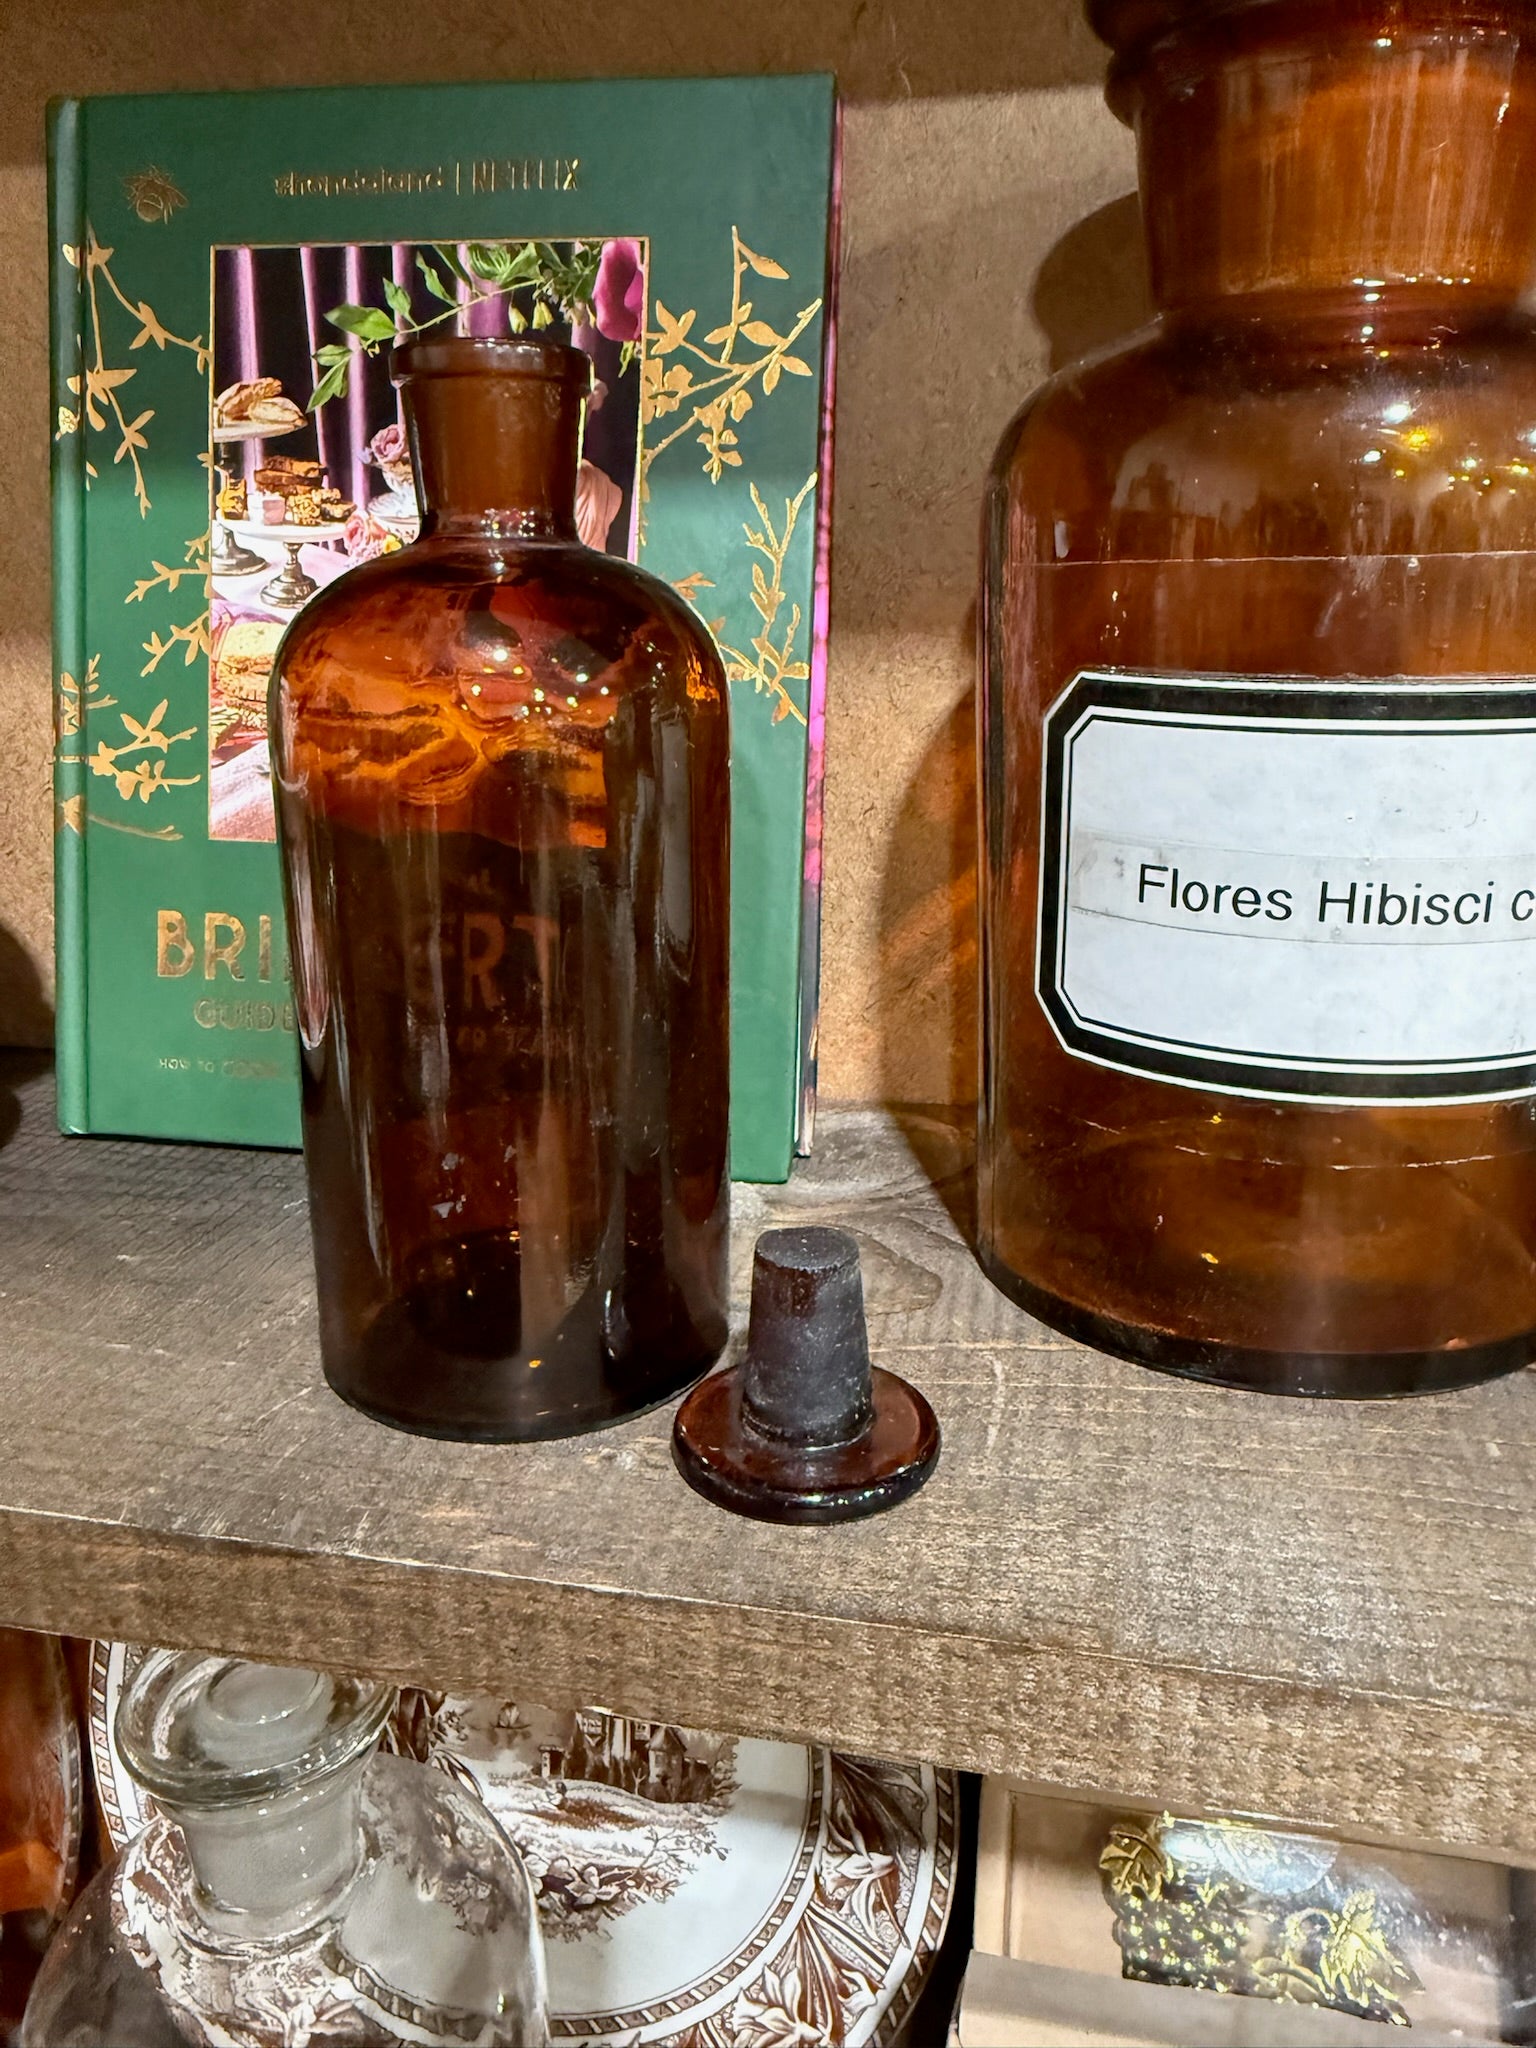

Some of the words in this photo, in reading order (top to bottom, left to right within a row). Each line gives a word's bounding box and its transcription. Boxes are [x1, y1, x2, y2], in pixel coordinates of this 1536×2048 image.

[1138, 862, 1293, 921] Flores
[1318, 880, 1495, 926] Hibisci
[157, 908, 294, 984] BRI
